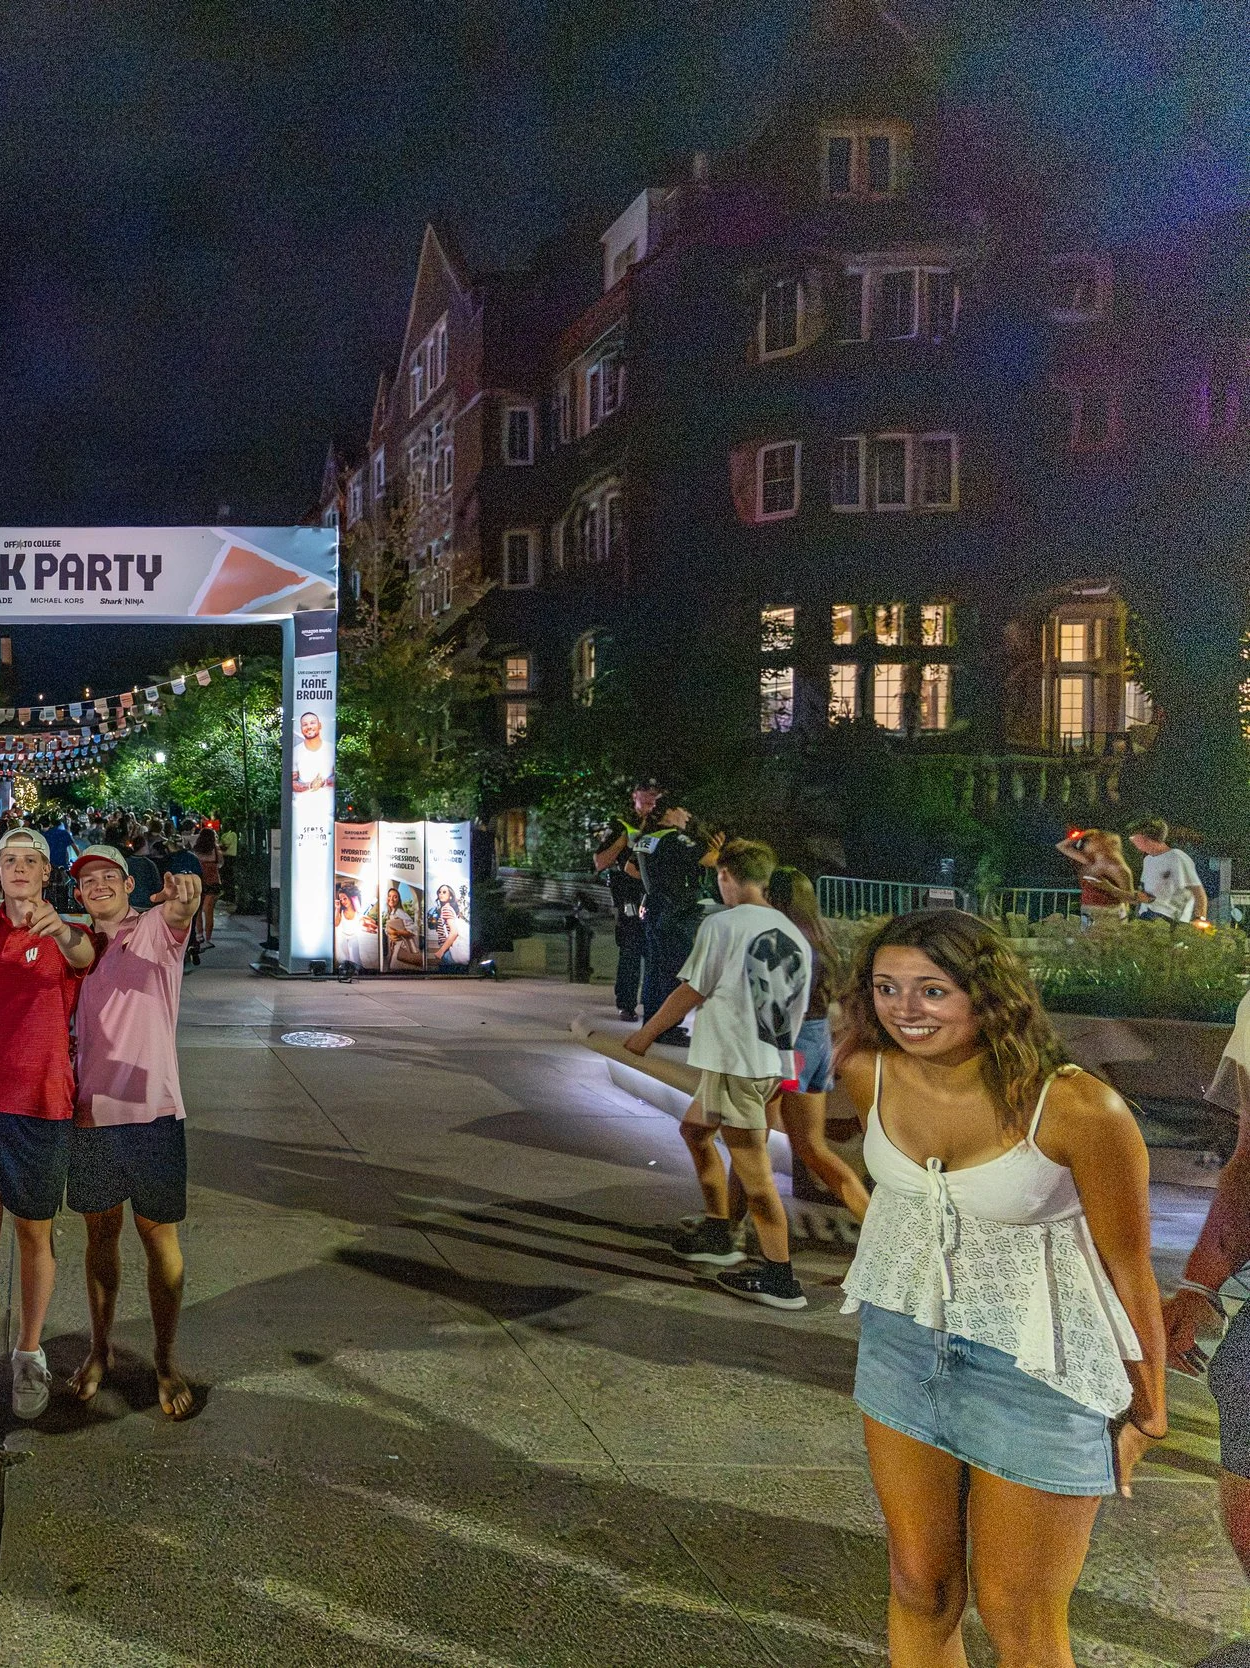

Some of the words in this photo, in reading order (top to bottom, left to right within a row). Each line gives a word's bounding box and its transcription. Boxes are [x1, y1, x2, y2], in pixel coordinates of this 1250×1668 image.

[23, 540, 33, 548] TO
[33, 540, 61, 548] COLLEGE
[34, 553, 162, 591] PARTY
[100, 597, 122, 605] Shark
[125, 597, 145, 606] NINJA
[301, 678, 327, 689] KANE
[296, 689, 333, 700] BROWN
[25, 947, 39, 963] W
